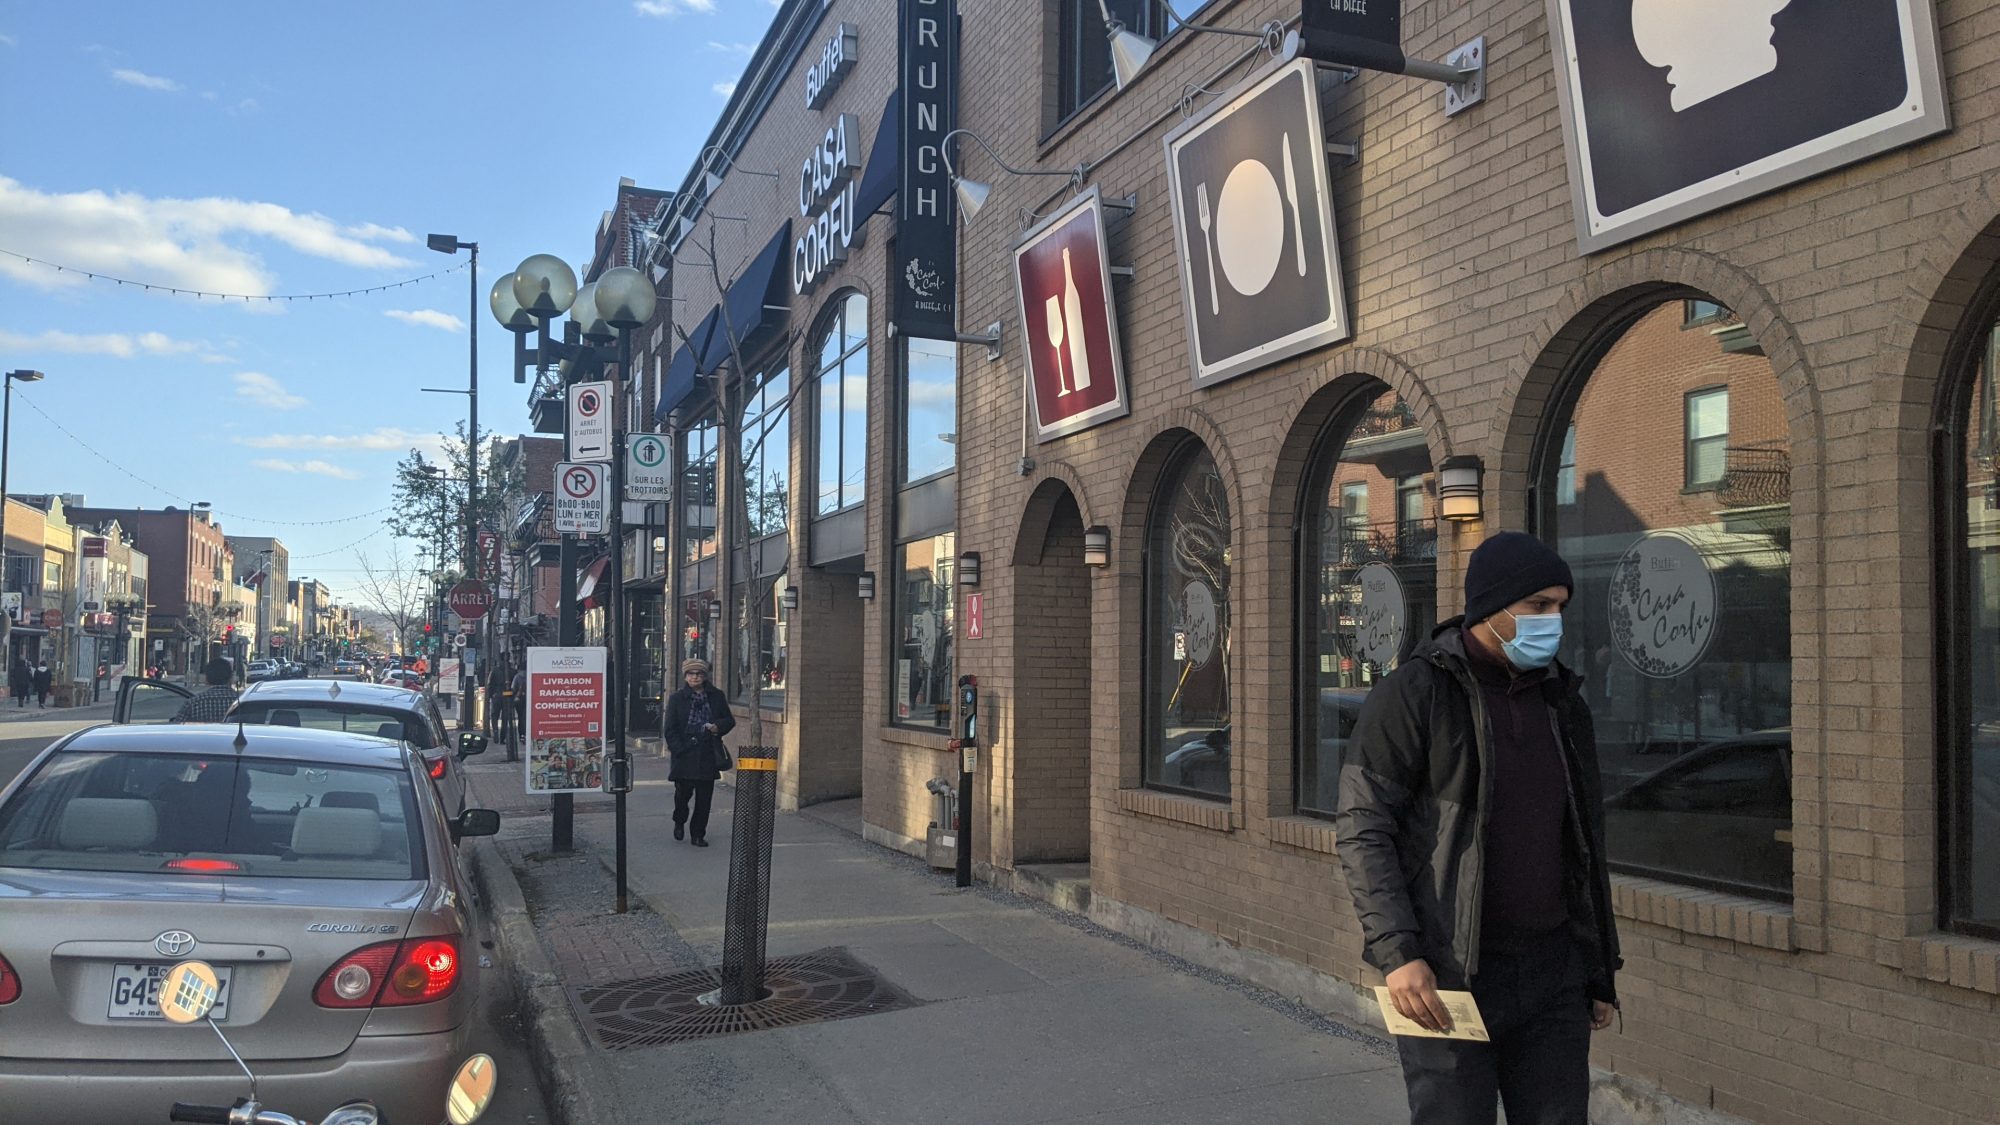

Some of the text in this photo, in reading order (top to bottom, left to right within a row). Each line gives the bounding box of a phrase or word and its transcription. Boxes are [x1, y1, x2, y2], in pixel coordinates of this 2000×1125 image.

[807, 23, 844, 110] Buffet
[917, 0, 939, 217] RUNCH
[801, 113, 848, 218] CASA
[793, 180, 854, 295] CORFU
[634, 476, 664, 485] SUR LES
[630, 486, 669, 495] TROTTOIRS
[557, 500, 601, 509] 8h00-9h00
[557, 510, 573, 519] LUN
[584, 510, 600, 520] MER
[452, 592, 491, 605] ARRÊT
[1638, 584, 1685, 621] Casa
[1653, 600, 1710, 649] Corfu
[543, 677, 592, 685] LIVRAISON
[539, 689, 595, 697] RAMASSAGE
[535, 702, 600, 710] COMMERÇANT
[307, 923, 377, 934] COROLLA
